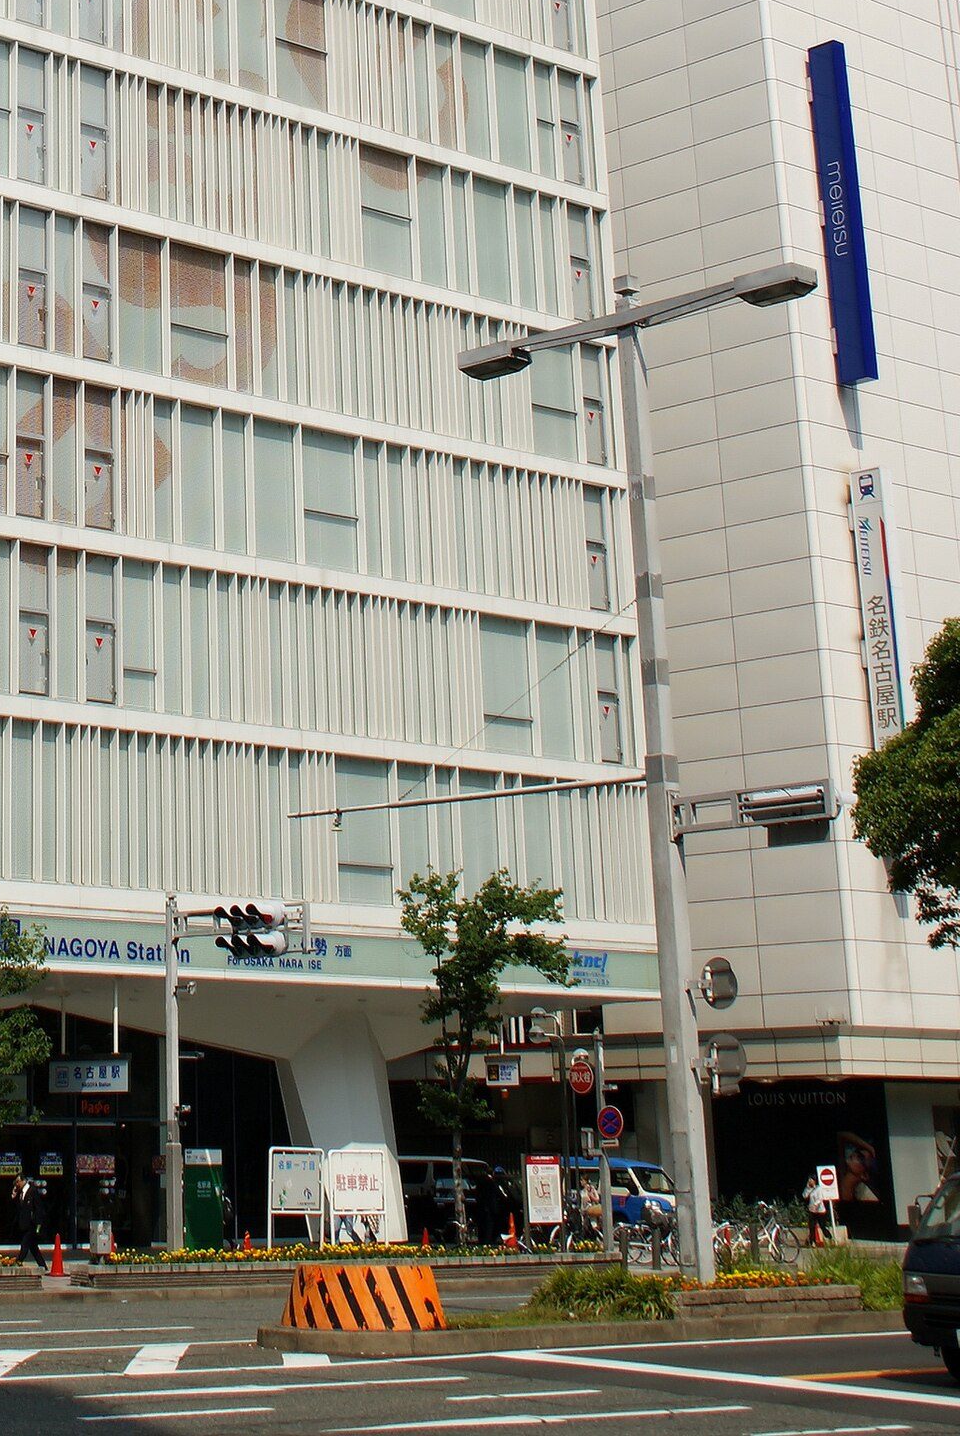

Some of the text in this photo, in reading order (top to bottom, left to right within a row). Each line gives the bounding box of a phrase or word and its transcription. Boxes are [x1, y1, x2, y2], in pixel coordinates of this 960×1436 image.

[867, 595, 898, 729] 名鉄名古屋駅
[43, 936, 120, 959] NAGOYA
[279, 958, 304, 969] NARA
[308, 959, 322, 970] ISE
[73, 1064, 121, 1079] 名古屋駅
[747, 1090, 847, 1106] LOUIS VUITTON
[336, 1173, 380, 1192] 駐車禁止
